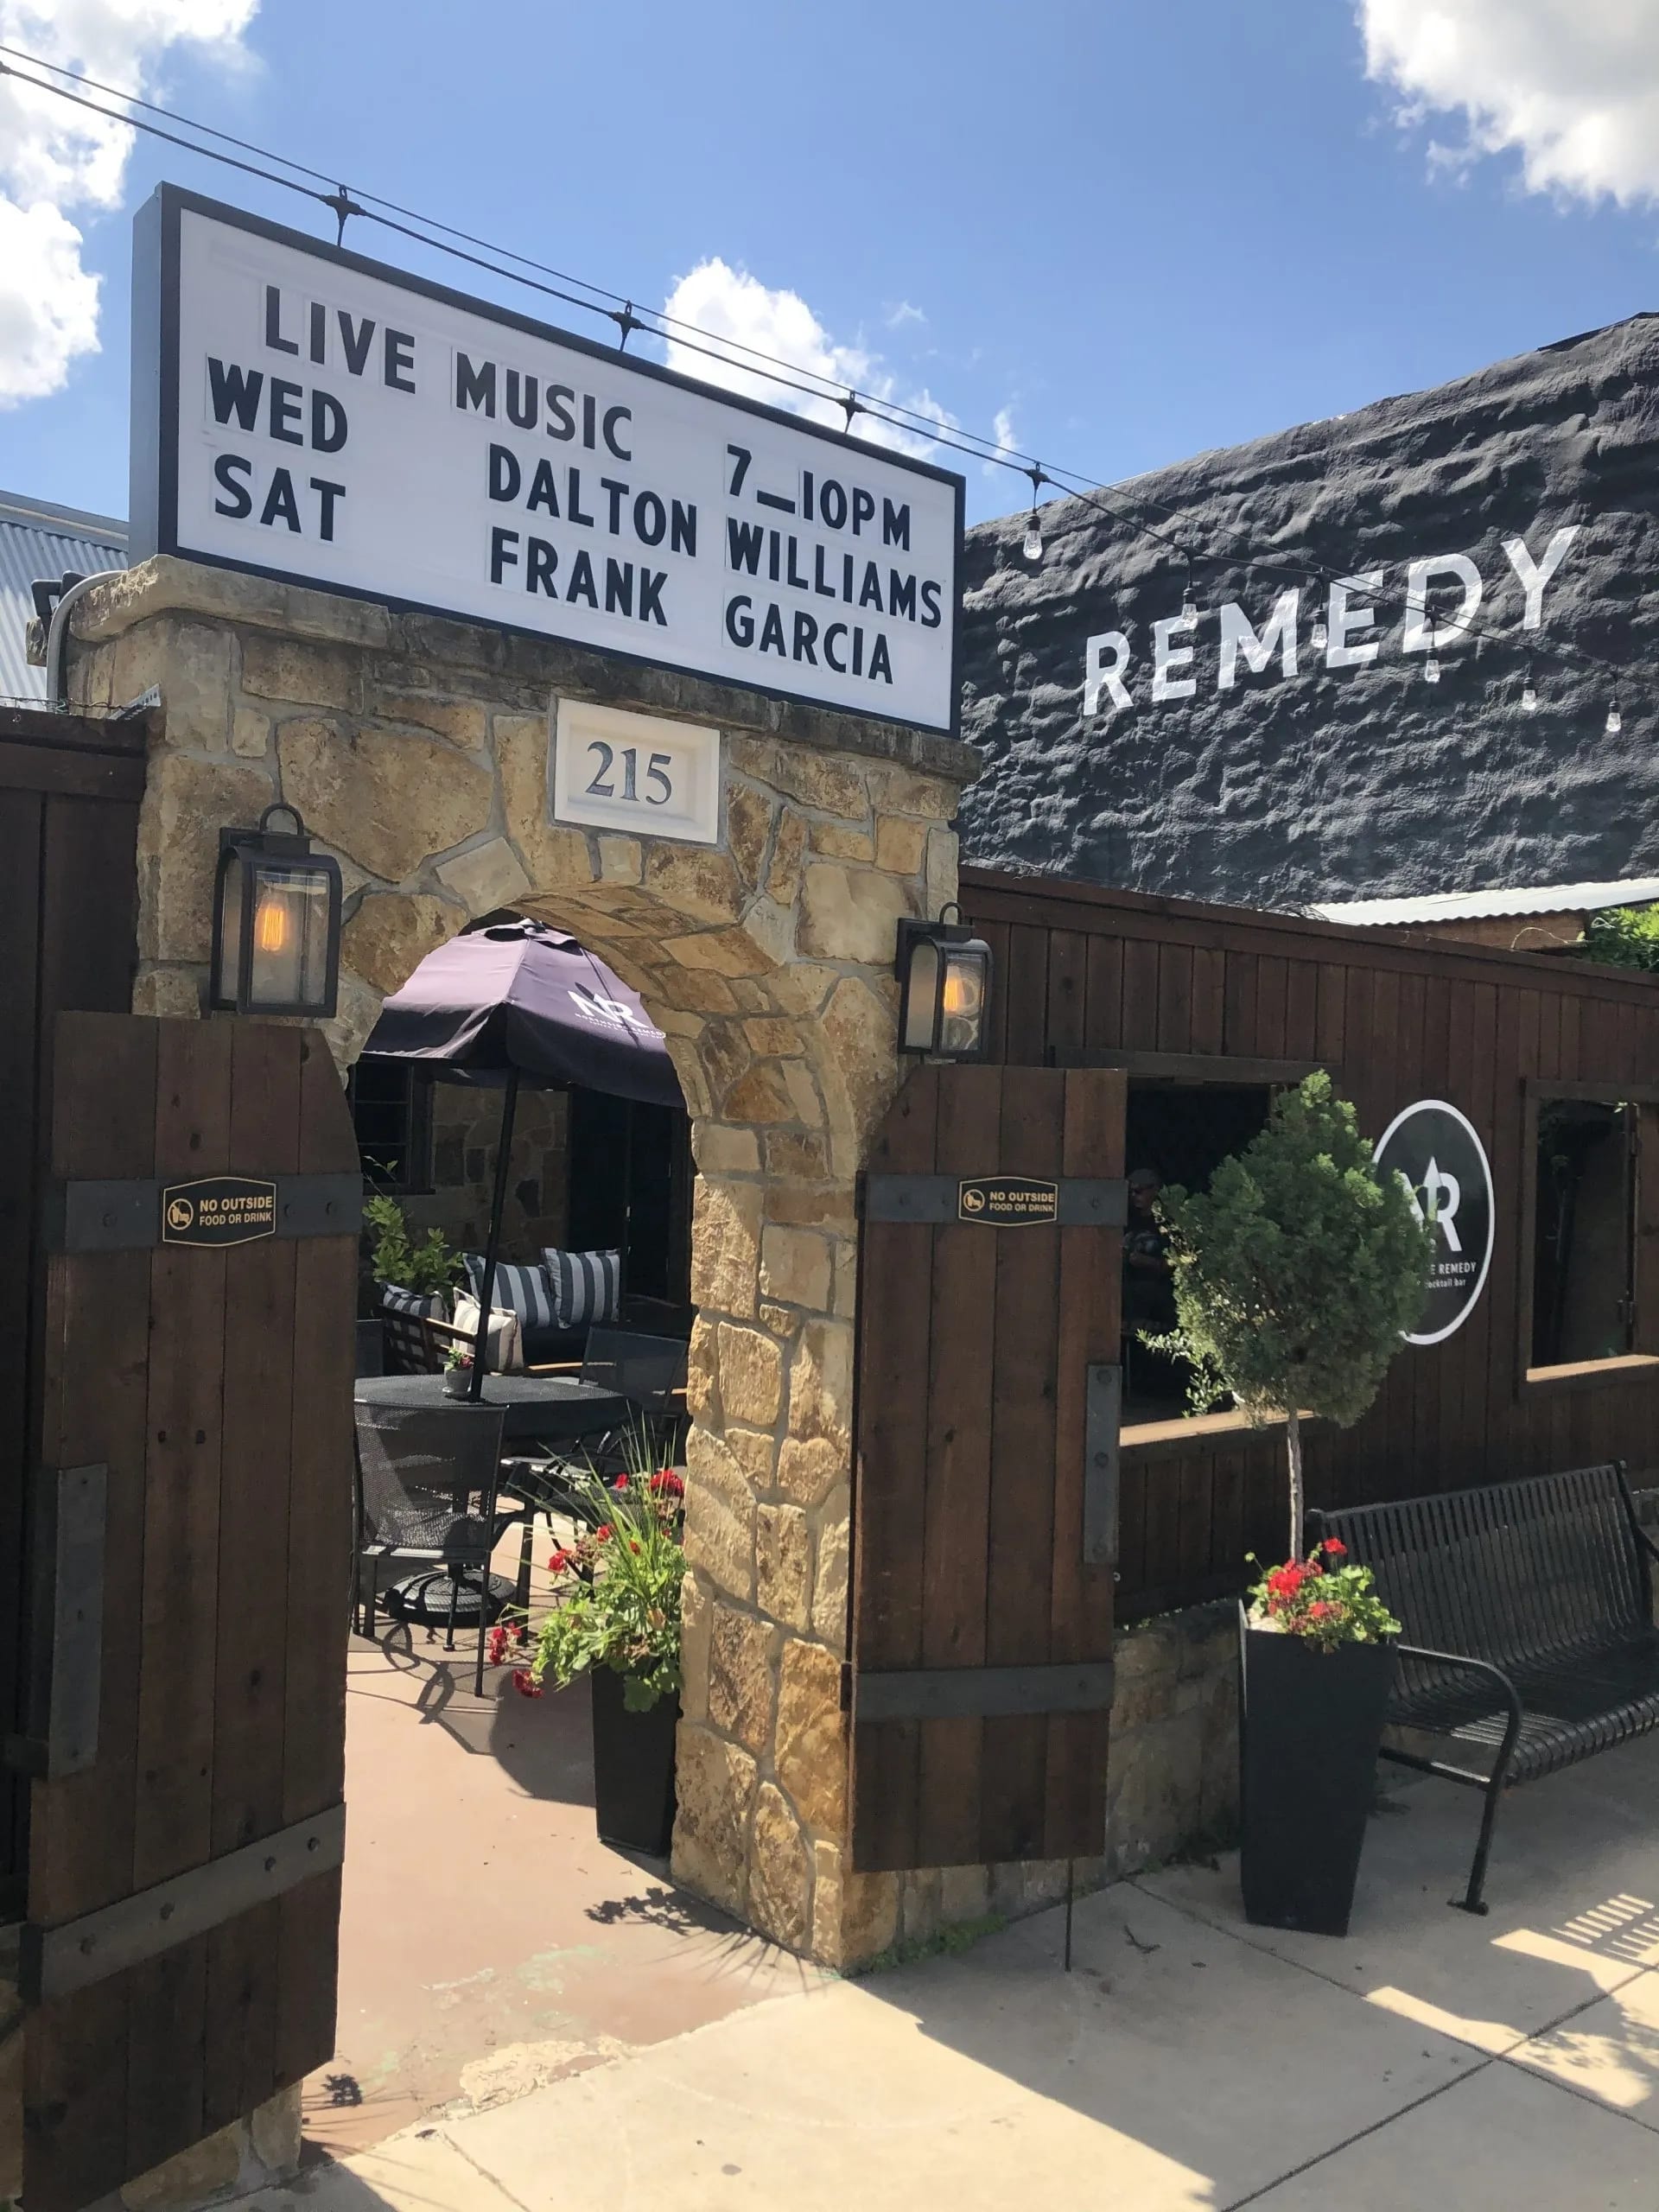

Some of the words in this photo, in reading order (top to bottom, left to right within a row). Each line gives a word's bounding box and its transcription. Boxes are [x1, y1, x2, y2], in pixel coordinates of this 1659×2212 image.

[265, 284, 416, 395] LIVE
[455, 352, 632, 462] MUSIC
[207, 356, 348, 454] WED
[488, 442, 697, 557] DALTON
[727, 517, 942, 629] WILLIAMS
[213, 454, 347, 543] SAT
[490, 525, 669, 626] FRANK
[725, 594, 894, 685] GARCIA
[1083, 524, 1582, 716] REMEDY
[584, 741, 672, 805] 215
[200, 1198, 218, 1212] NO
[221, 1196, 273, 1211] OUTSIDE
[989, 1192, 1006, 1201] NO
[1008, 1192, 1055, 1203] OUTSIDE
[989, 1202, 1013, 1211] FOOD
[1014, 1203, 1027, 1212] OR
[1028, 1204, 1054, 1213] DRINK
[200, 1215, 226, 1226] FOOD
[228, 1214, 242, 1224] OR
[244, 1211, 272, 1223] DRINK
[1439, 1262, 1477, 1274] REMEDY
[1454, 1278, 1466, 1287] bar
